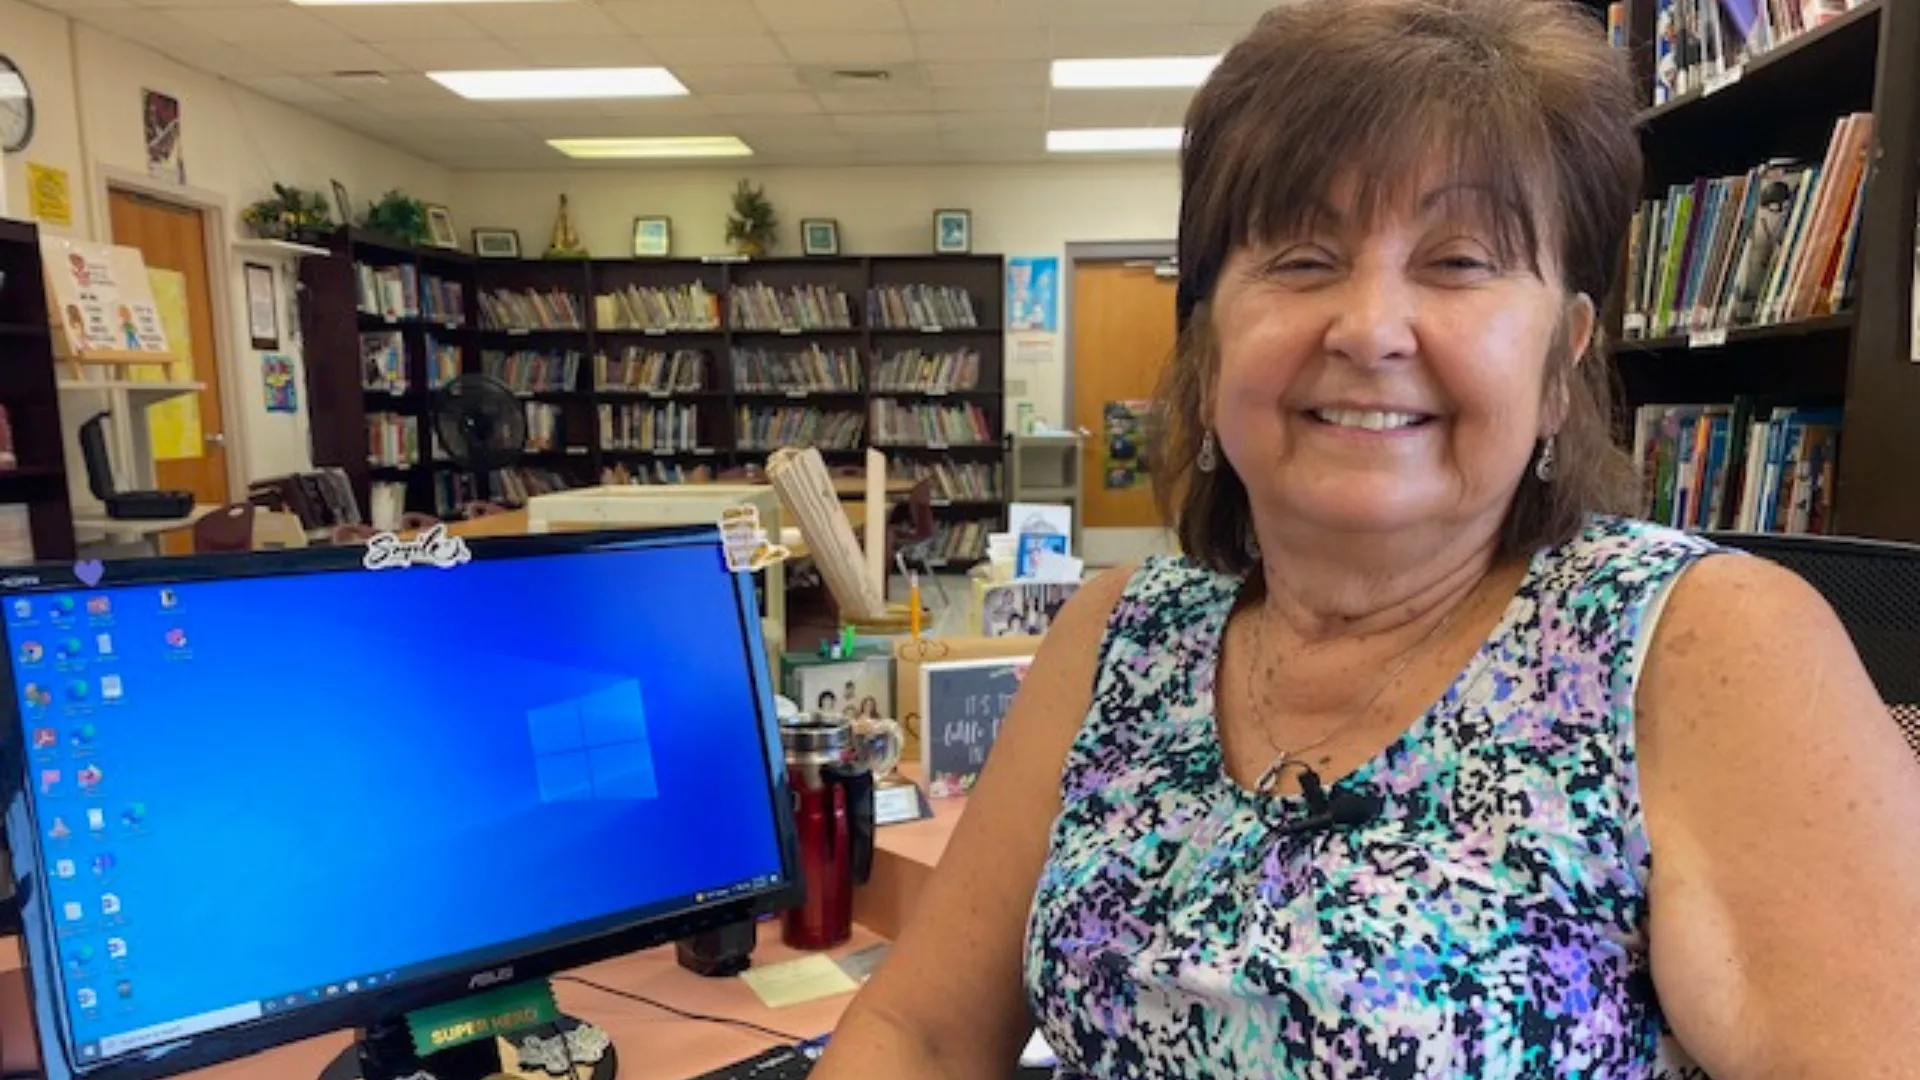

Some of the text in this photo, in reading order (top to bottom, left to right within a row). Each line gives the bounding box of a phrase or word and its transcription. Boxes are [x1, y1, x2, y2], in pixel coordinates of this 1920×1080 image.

[467, 965, 514, 989] ASUS
[431, 1008, 538, 1045] SUPER HERO
